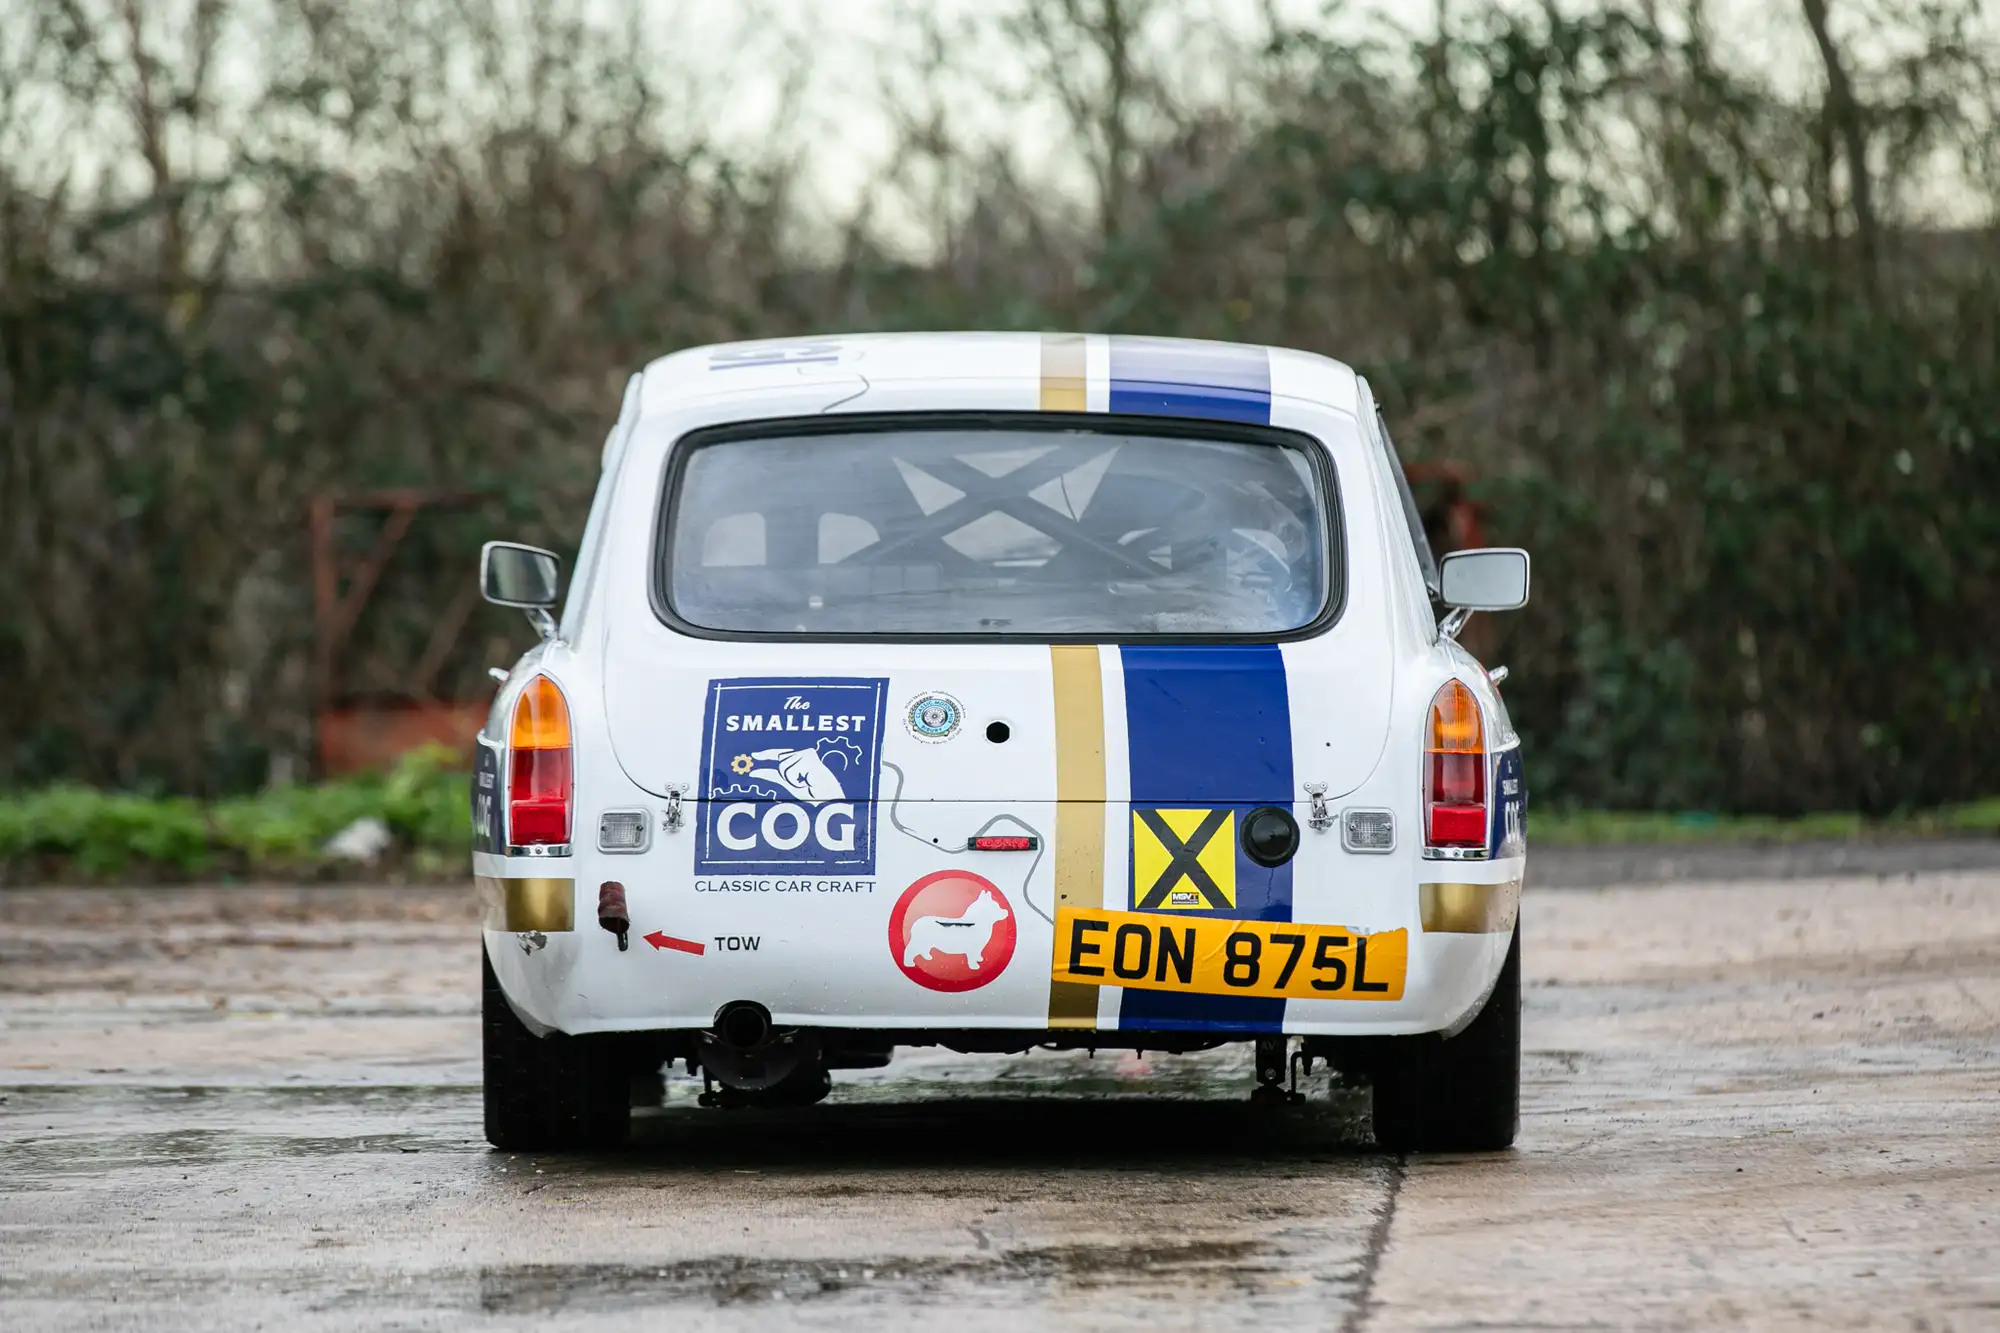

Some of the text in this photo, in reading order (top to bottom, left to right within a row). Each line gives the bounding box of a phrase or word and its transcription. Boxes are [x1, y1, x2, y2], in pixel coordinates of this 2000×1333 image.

[783, 695, 811, 710] The
[726, 714, 866, 732] SMALLEST
[716, 802, 856, 852] COG
[694, 880, 877, 893] CLASSIC CAR CRAFT
[714, 936, 761, 951] TOW
[1068, 918, 1389, 993] EON 875L
